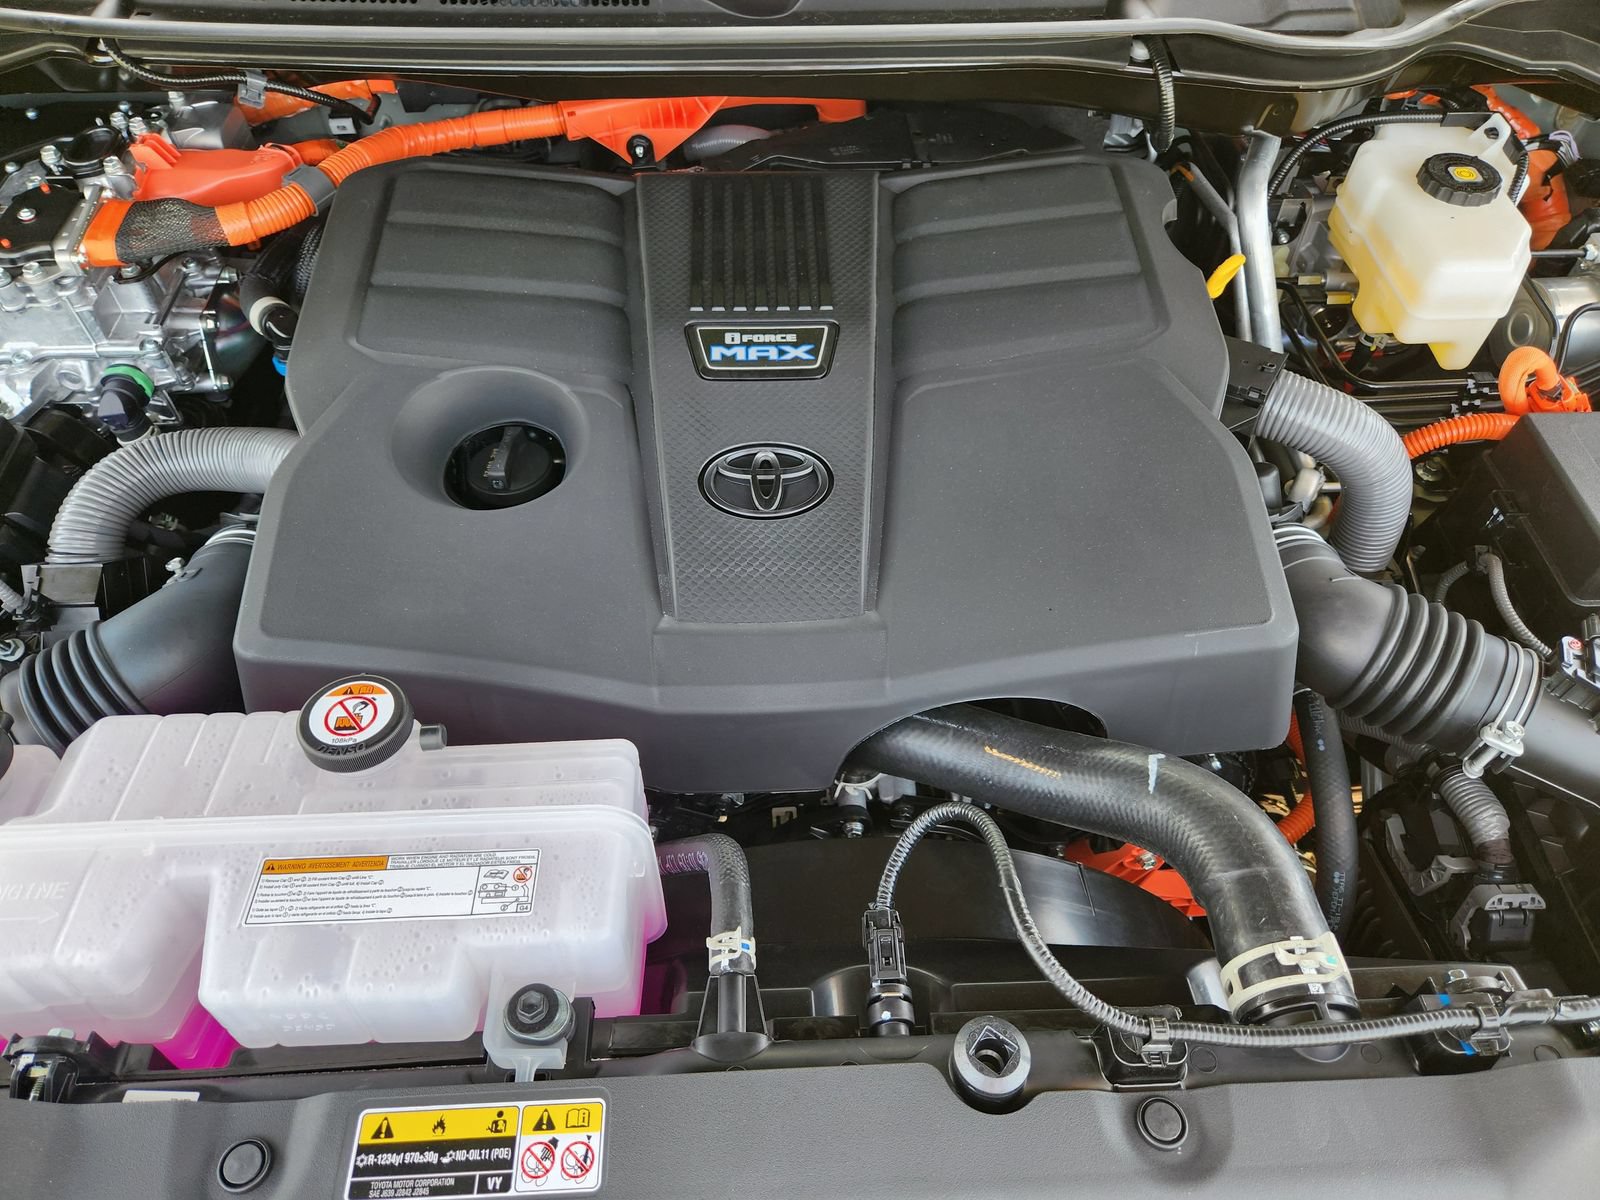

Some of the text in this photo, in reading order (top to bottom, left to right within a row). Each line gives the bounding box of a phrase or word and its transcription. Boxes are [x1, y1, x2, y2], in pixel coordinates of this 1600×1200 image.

[742, 333, 797, 343] FORCE
[709, 343, 816, 362] MAX
[278, 863, 306, 871] WARNING
[368, 1148, 511, 1168] R-1234yf 970±30g ND-OIL11 (POE)
[370, 1178, 455, 1189] TOYOTA MOTOR CORPORATION
[486, 1176, 503, 1191] VY
[369, 1190, 381, 1198] SAE
[381, 1189, 394, 1198] J639
